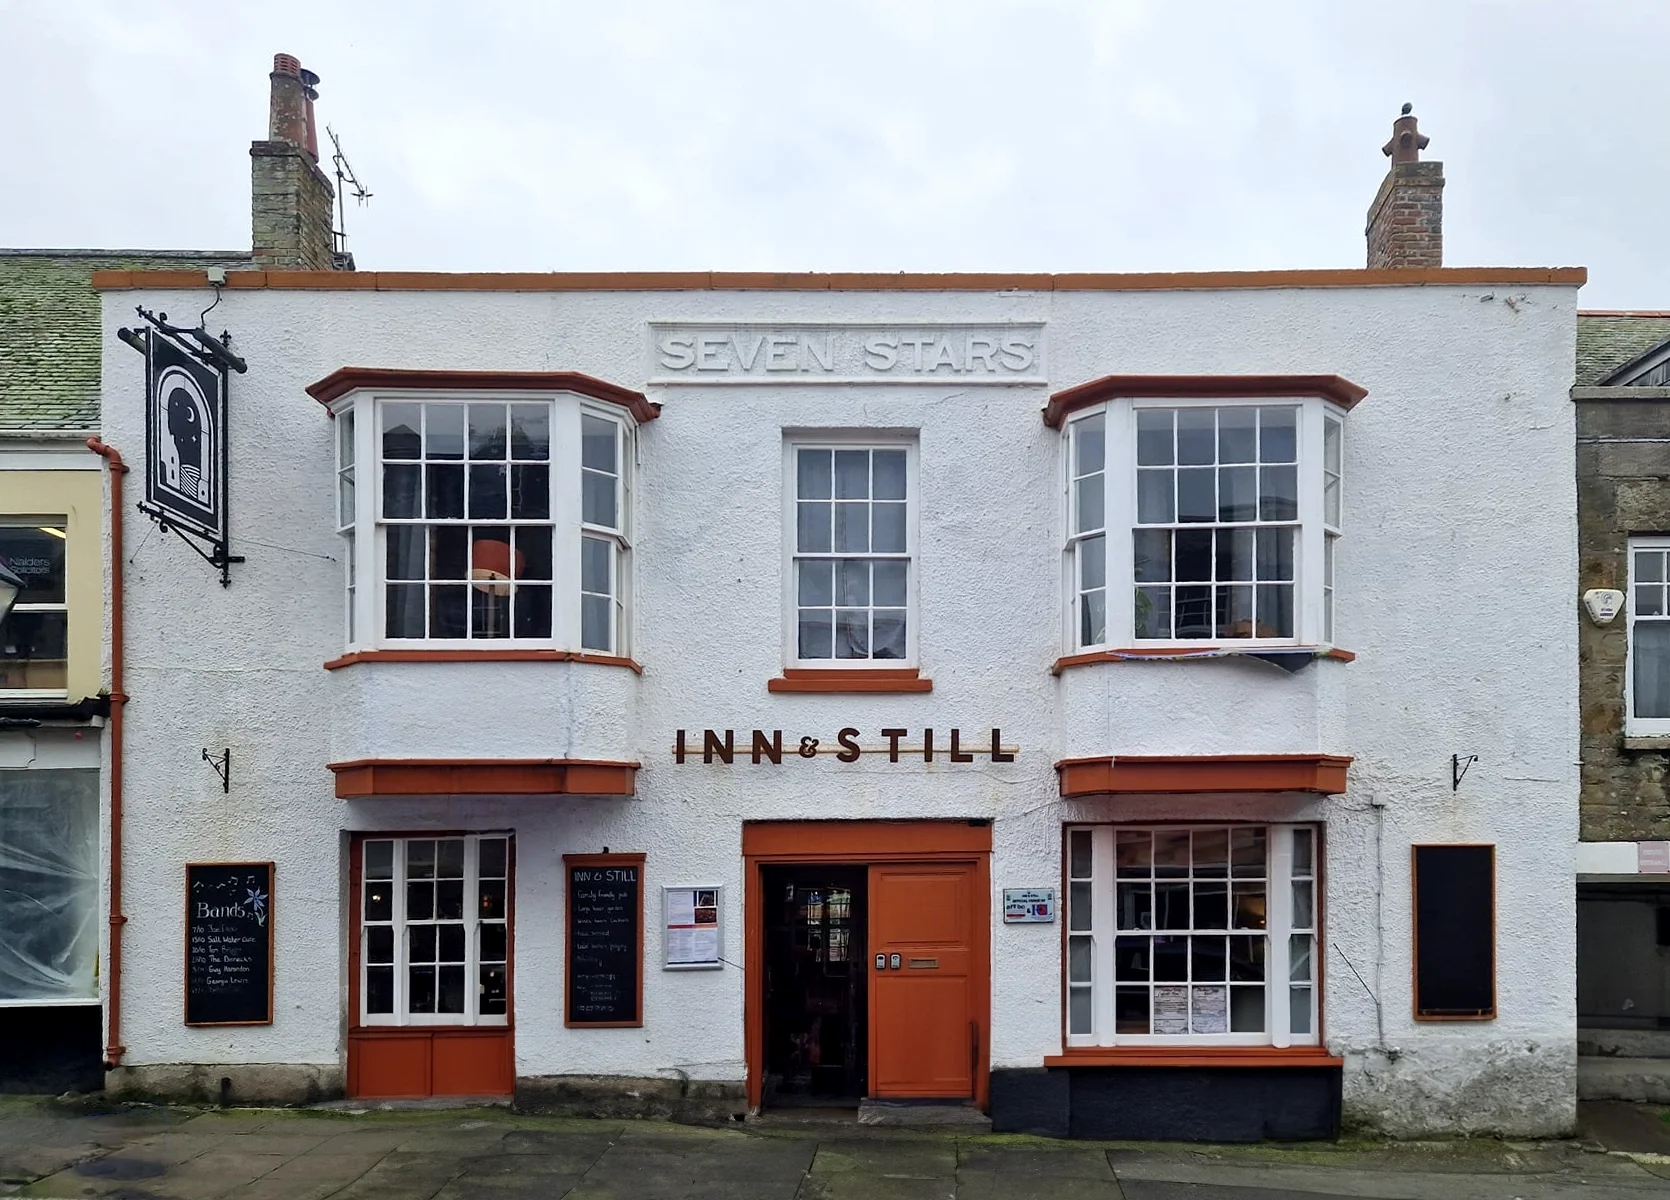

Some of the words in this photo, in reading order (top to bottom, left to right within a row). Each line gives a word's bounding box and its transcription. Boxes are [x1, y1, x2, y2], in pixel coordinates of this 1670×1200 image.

[660, 335, 834, 371] SEVEN
[864, 335, 1034, 371] STARS
[10, 557, 50, 567] Nalders
[676, 729, 782, 764] INN
[799, 736, 820, 758] &
[836, 727, 1015, 763] STILL
[574, 871, 591, 882] INN
[606, 870, 636, 882] STILL
[196, 902, 246, 918] Bands
[208, 954, 221, 963] The
